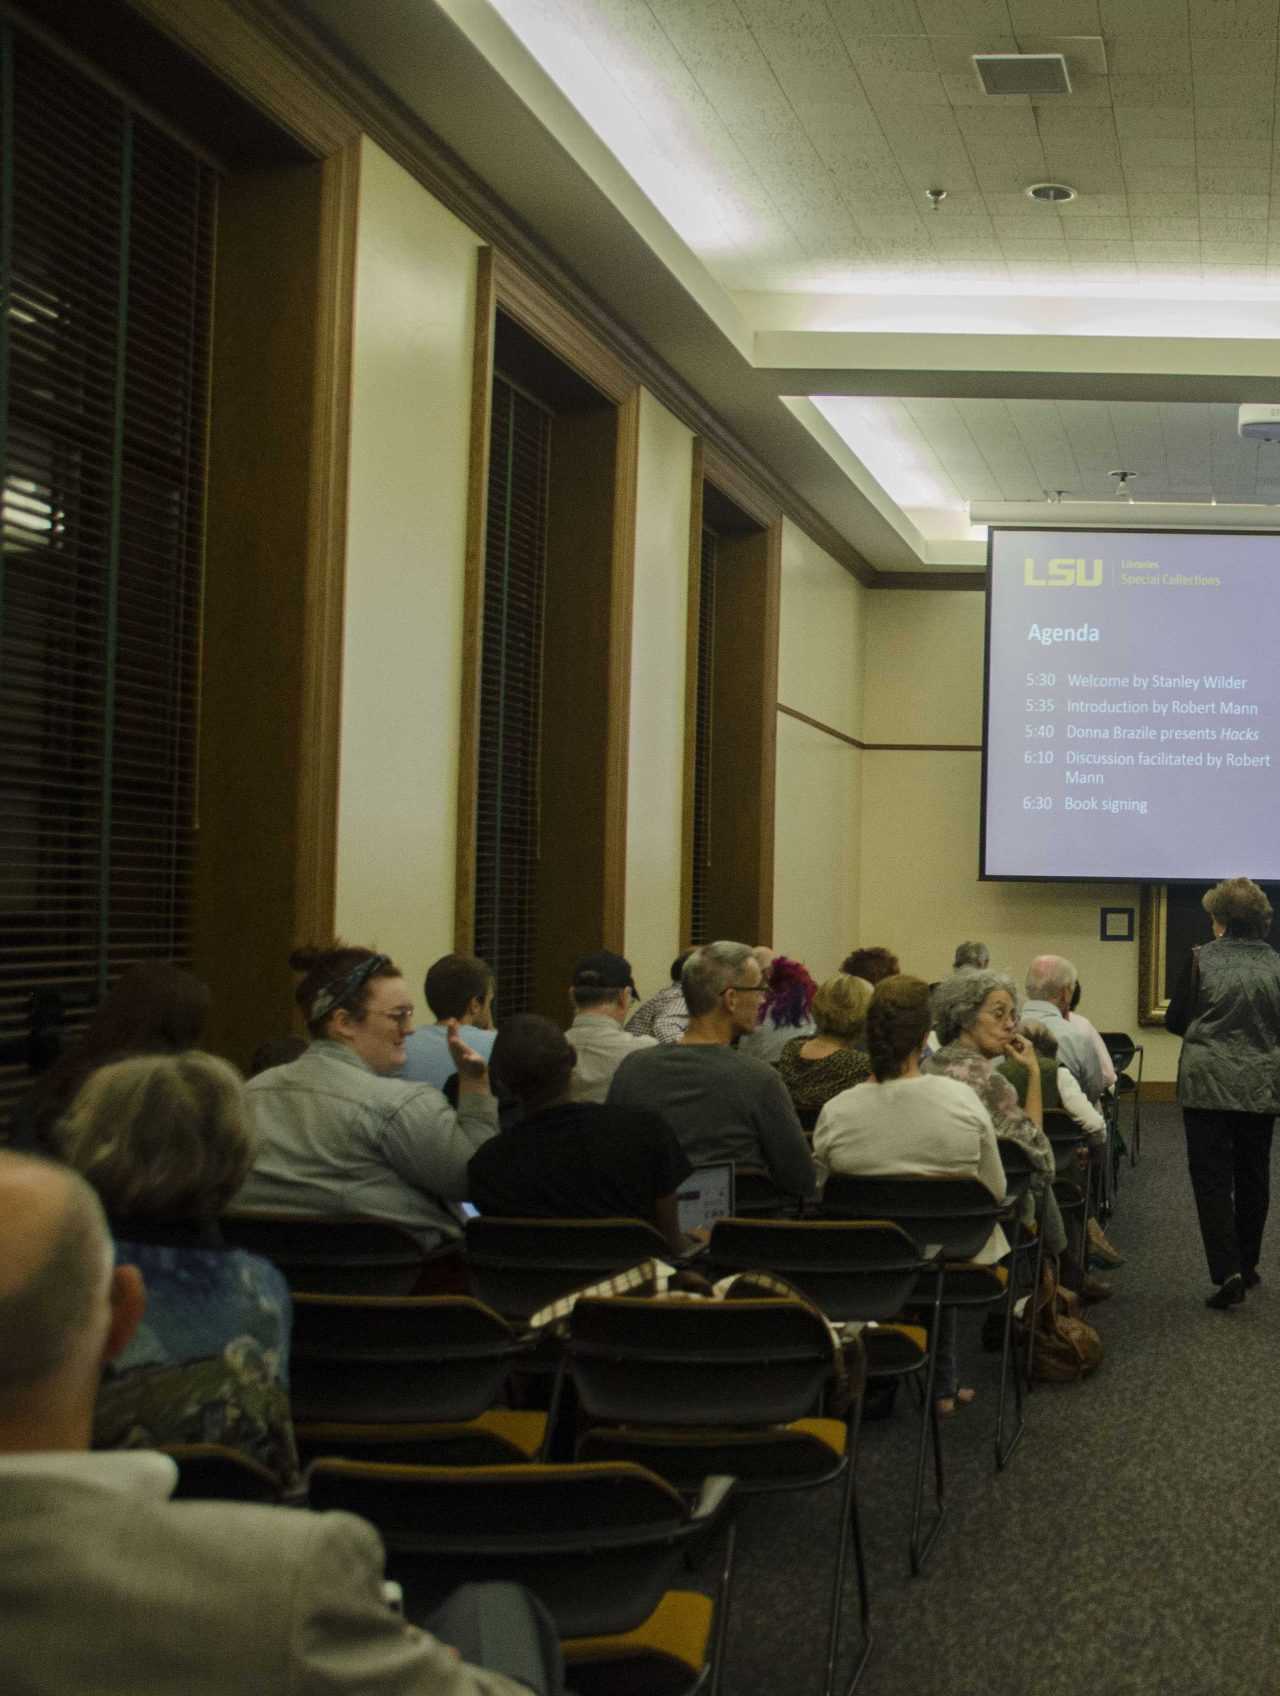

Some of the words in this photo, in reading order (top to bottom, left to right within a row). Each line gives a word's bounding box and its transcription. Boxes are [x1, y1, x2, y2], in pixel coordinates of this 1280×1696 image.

[1024, 558, 1103, 587] LSU
[1120, 574, 1160, 586] Special
[1162, 575, 1221, 586] Collections
[1028, 623, 1100, 645] Agenda
[1026, 673, 1056, 687] 5:30
[1068, 674, 1129, 688] Welcome
[1133, 675, 1149, 692] by
[1152, 676, 1200, 691] Stanley
[1202, 676, 1248, 689] Wilder
[1025, 699, 1054, 712] 5:35
[1067, 700, 1149, 714] Introduction
[1152, 700, 1168, 717] by
[1171, 701, 1216, 714] Robert
[1219, 702, 1258, 715] Mann
[1024, 725, 1054, 738] 5:40
[1067, 725, 1110, 739] Donna
[1113, 725, 1156, 740] Brazile
[1160, 727, 1216, 744] presents
[1220, 728, 1259, 741] Hacks
[1024, 751, 1054, 764] 6:10
[1066, 752, 1134, 766] Discussion
[1138, 752, 1203, 767] facilitated
[1206, 752, 1223, 769] by
[1226, 753, 1271, 767] Robert
[1065, 772, 1104, 784] Mann
[1023, 796, 1052, 810] 6:30
[1065, 797, 1098, 810] Book
[1102, 798, 1148, 814] signing
